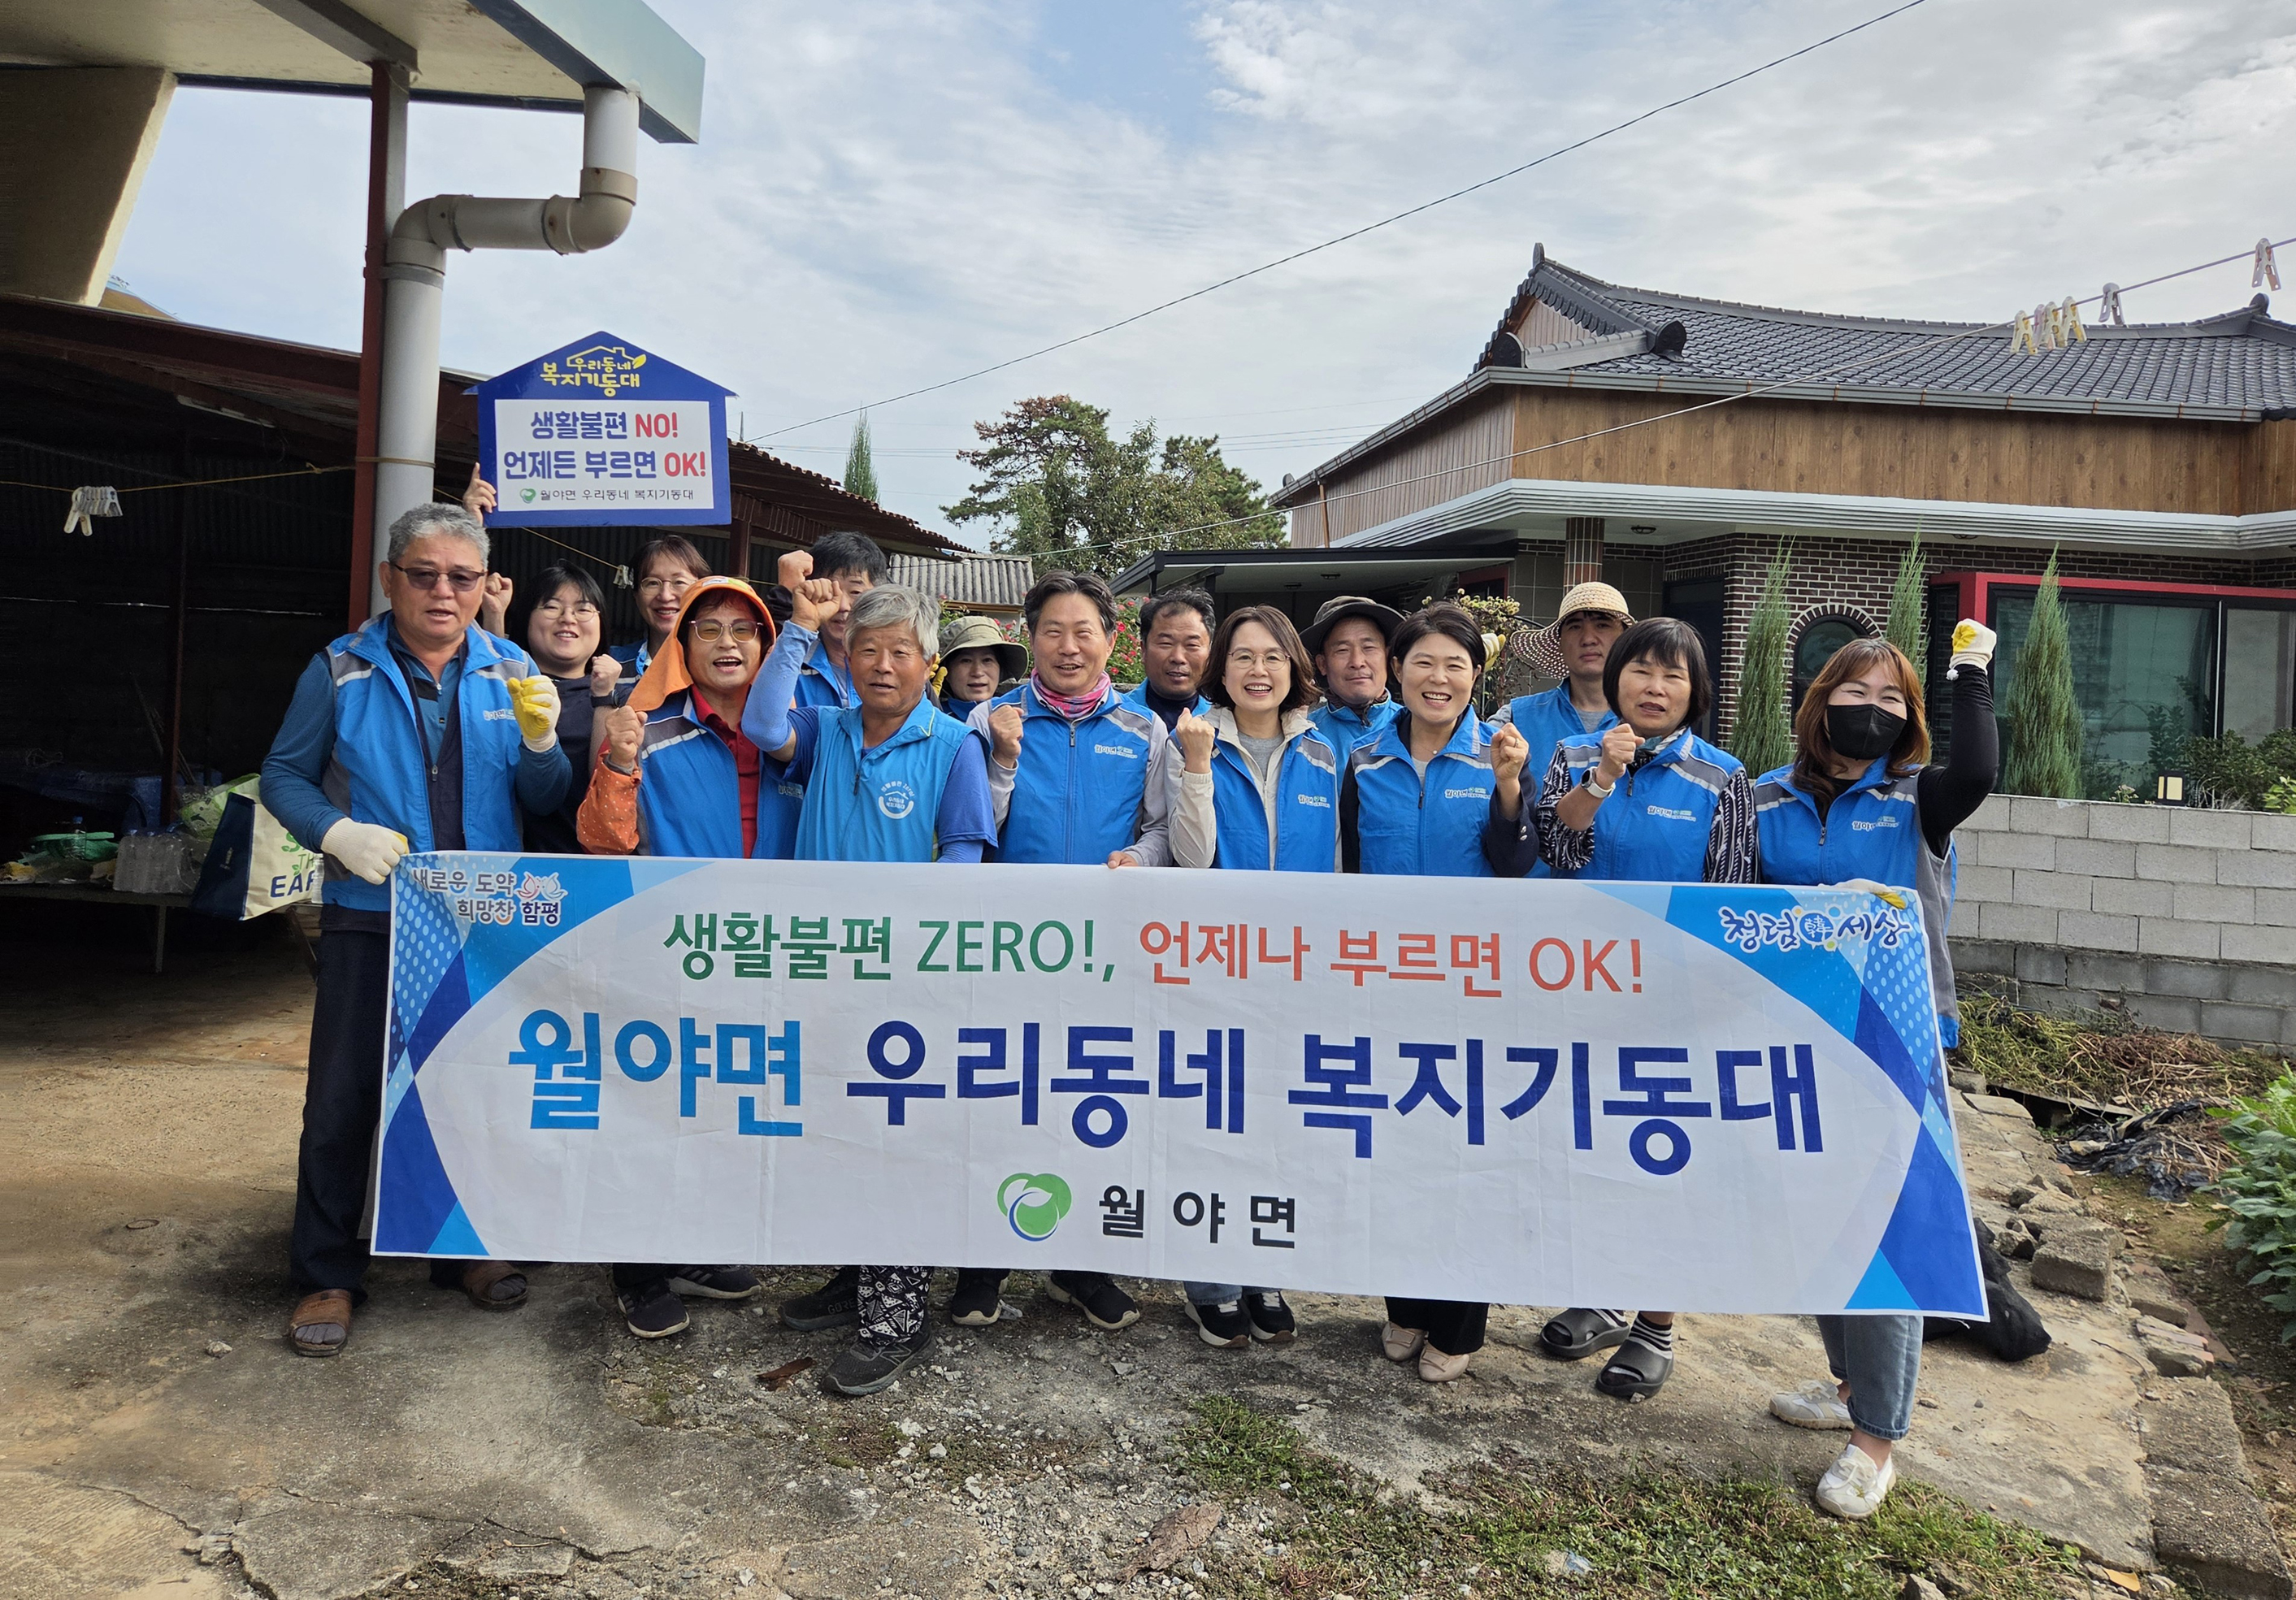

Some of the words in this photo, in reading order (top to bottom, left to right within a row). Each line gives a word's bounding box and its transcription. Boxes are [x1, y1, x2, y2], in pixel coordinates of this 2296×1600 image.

[570, 357, 632, 373] 우리동네
[540, 362, 640, 397] 복지기동대
[531, 411, 628, 440] 생활불편
[635, 412, 679, 438] NO!
[503, 451, 576, 479] 언제든
[585, 451, 657, 479] 부르면
[663, 452, 706, 477] OK!
[540, 490, 576, 501] 월야면
[582, 489, 629, 501] 우리동네
[634, 489, 694, 501] 복지기동대
[413, 869, 468, 894] 새로운
[475, 874, 514, 895] 도약
[457, 899, 514, 924] 희망찬
[521, 901, 561, 924] 함평
[663, 913, 892, 981] 생활불편
[917, 919, 1116, 983] ZERO!,
[1139, 921, 1311, 985] 언제나
[1330, 930, 1502, 998] 부르면
[1528, 937, 1643, 994] OK!
[508, 1009, 803, 1137] 월야면
[847, 1020, 1244, 1149] 우리동네
[1287, 1034, 1823, 1176] 복지기동대
